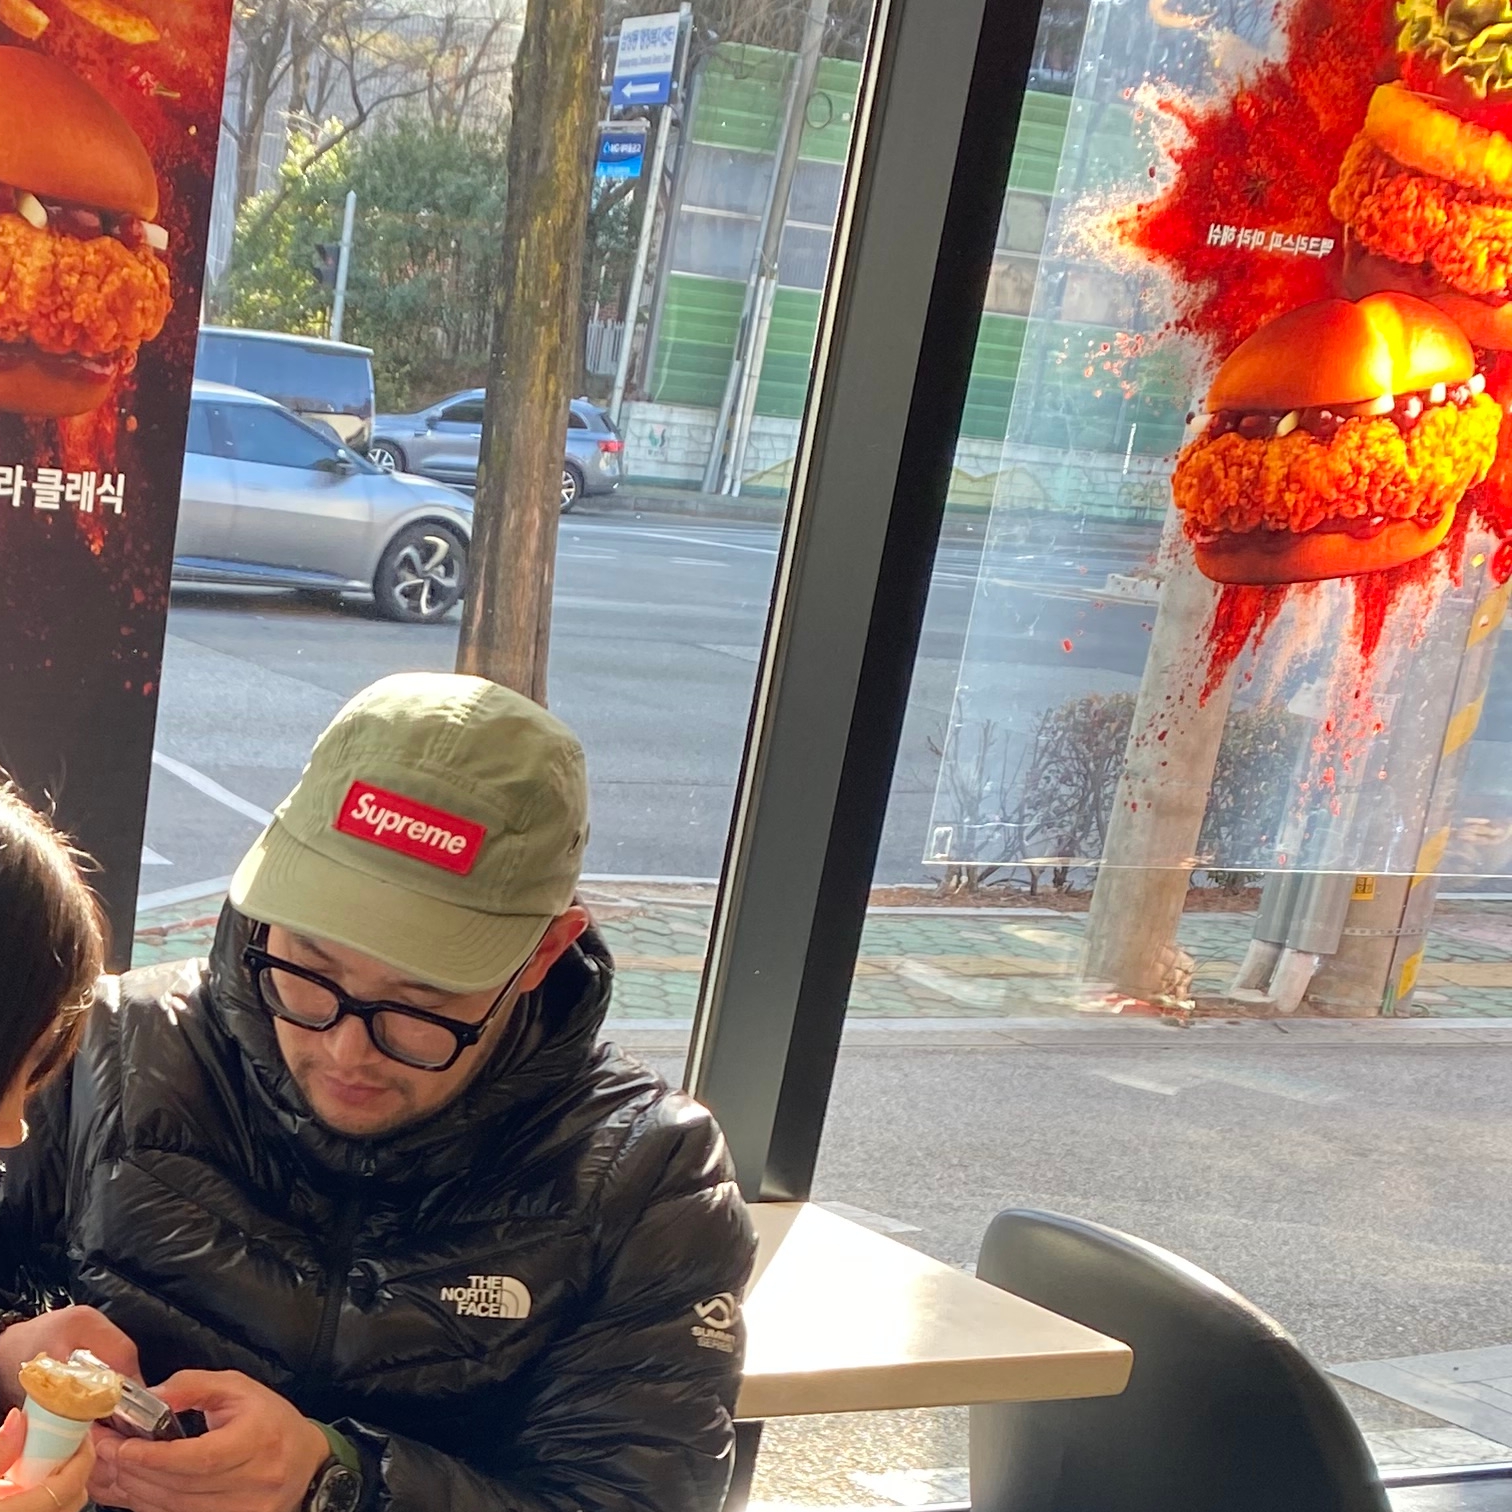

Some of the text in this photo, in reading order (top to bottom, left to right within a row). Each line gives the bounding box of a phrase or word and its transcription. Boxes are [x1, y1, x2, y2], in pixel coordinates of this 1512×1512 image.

[32, 467, 126, 514] 클래식
[351, 792, 467, 854] Supreme
[467, 1275, 502, 1289] THE
[440, 1287, 502, 1303] NORTH
[456, 1302, 501, 1318] FACE
